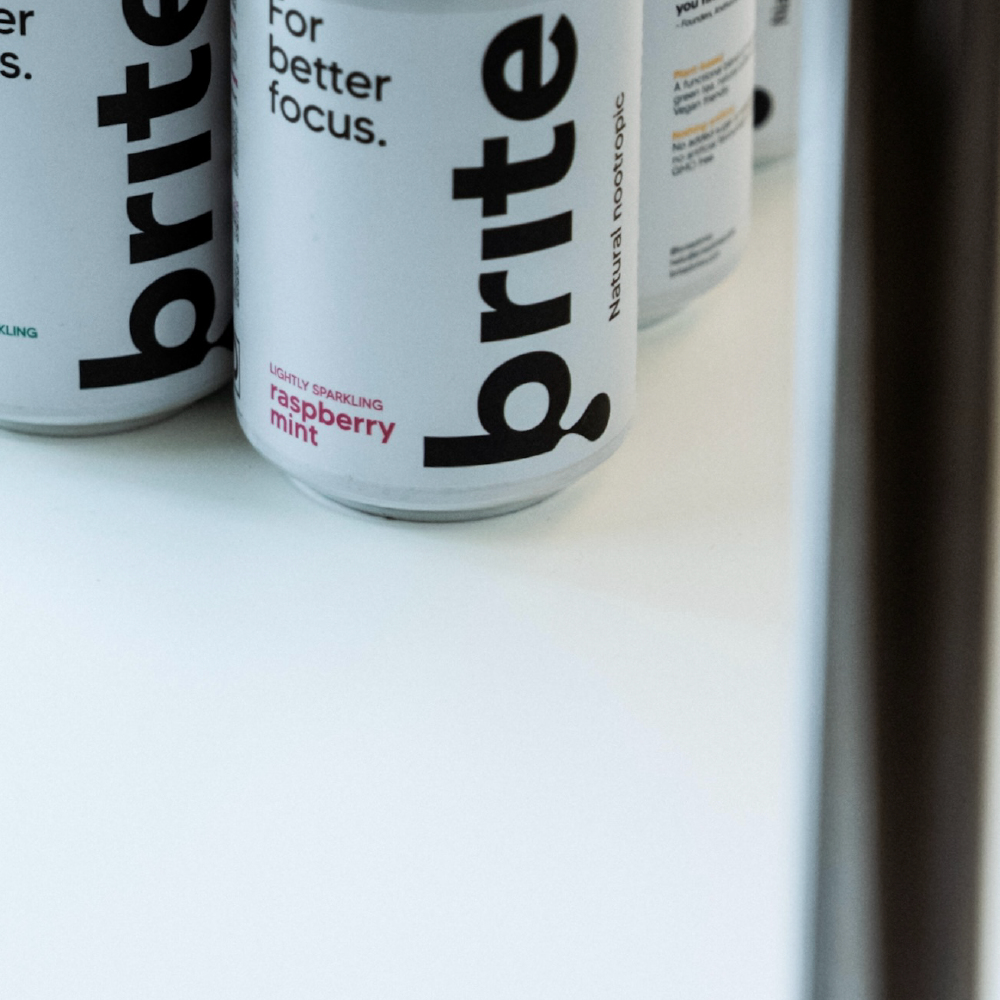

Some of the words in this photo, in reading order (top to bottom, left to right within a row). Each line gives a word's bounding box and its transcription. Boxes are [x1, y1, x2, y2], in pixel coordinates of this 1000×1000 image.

[676, 0, 699, 17] you
[268, 34, 392, 102] better
[268, 80, 388, 147] focus.
[612, 91, 627, 222] nootropic
[423, 13, 579, 468] brite
[608, 226, 623, 322] Natural
[269, 361, 310, 391] LIGHTLY
[312, 383, 384, 411] SPARKLING
[270, 383, 396, 444] raspberry
[270, 408, 318, 446] mint
